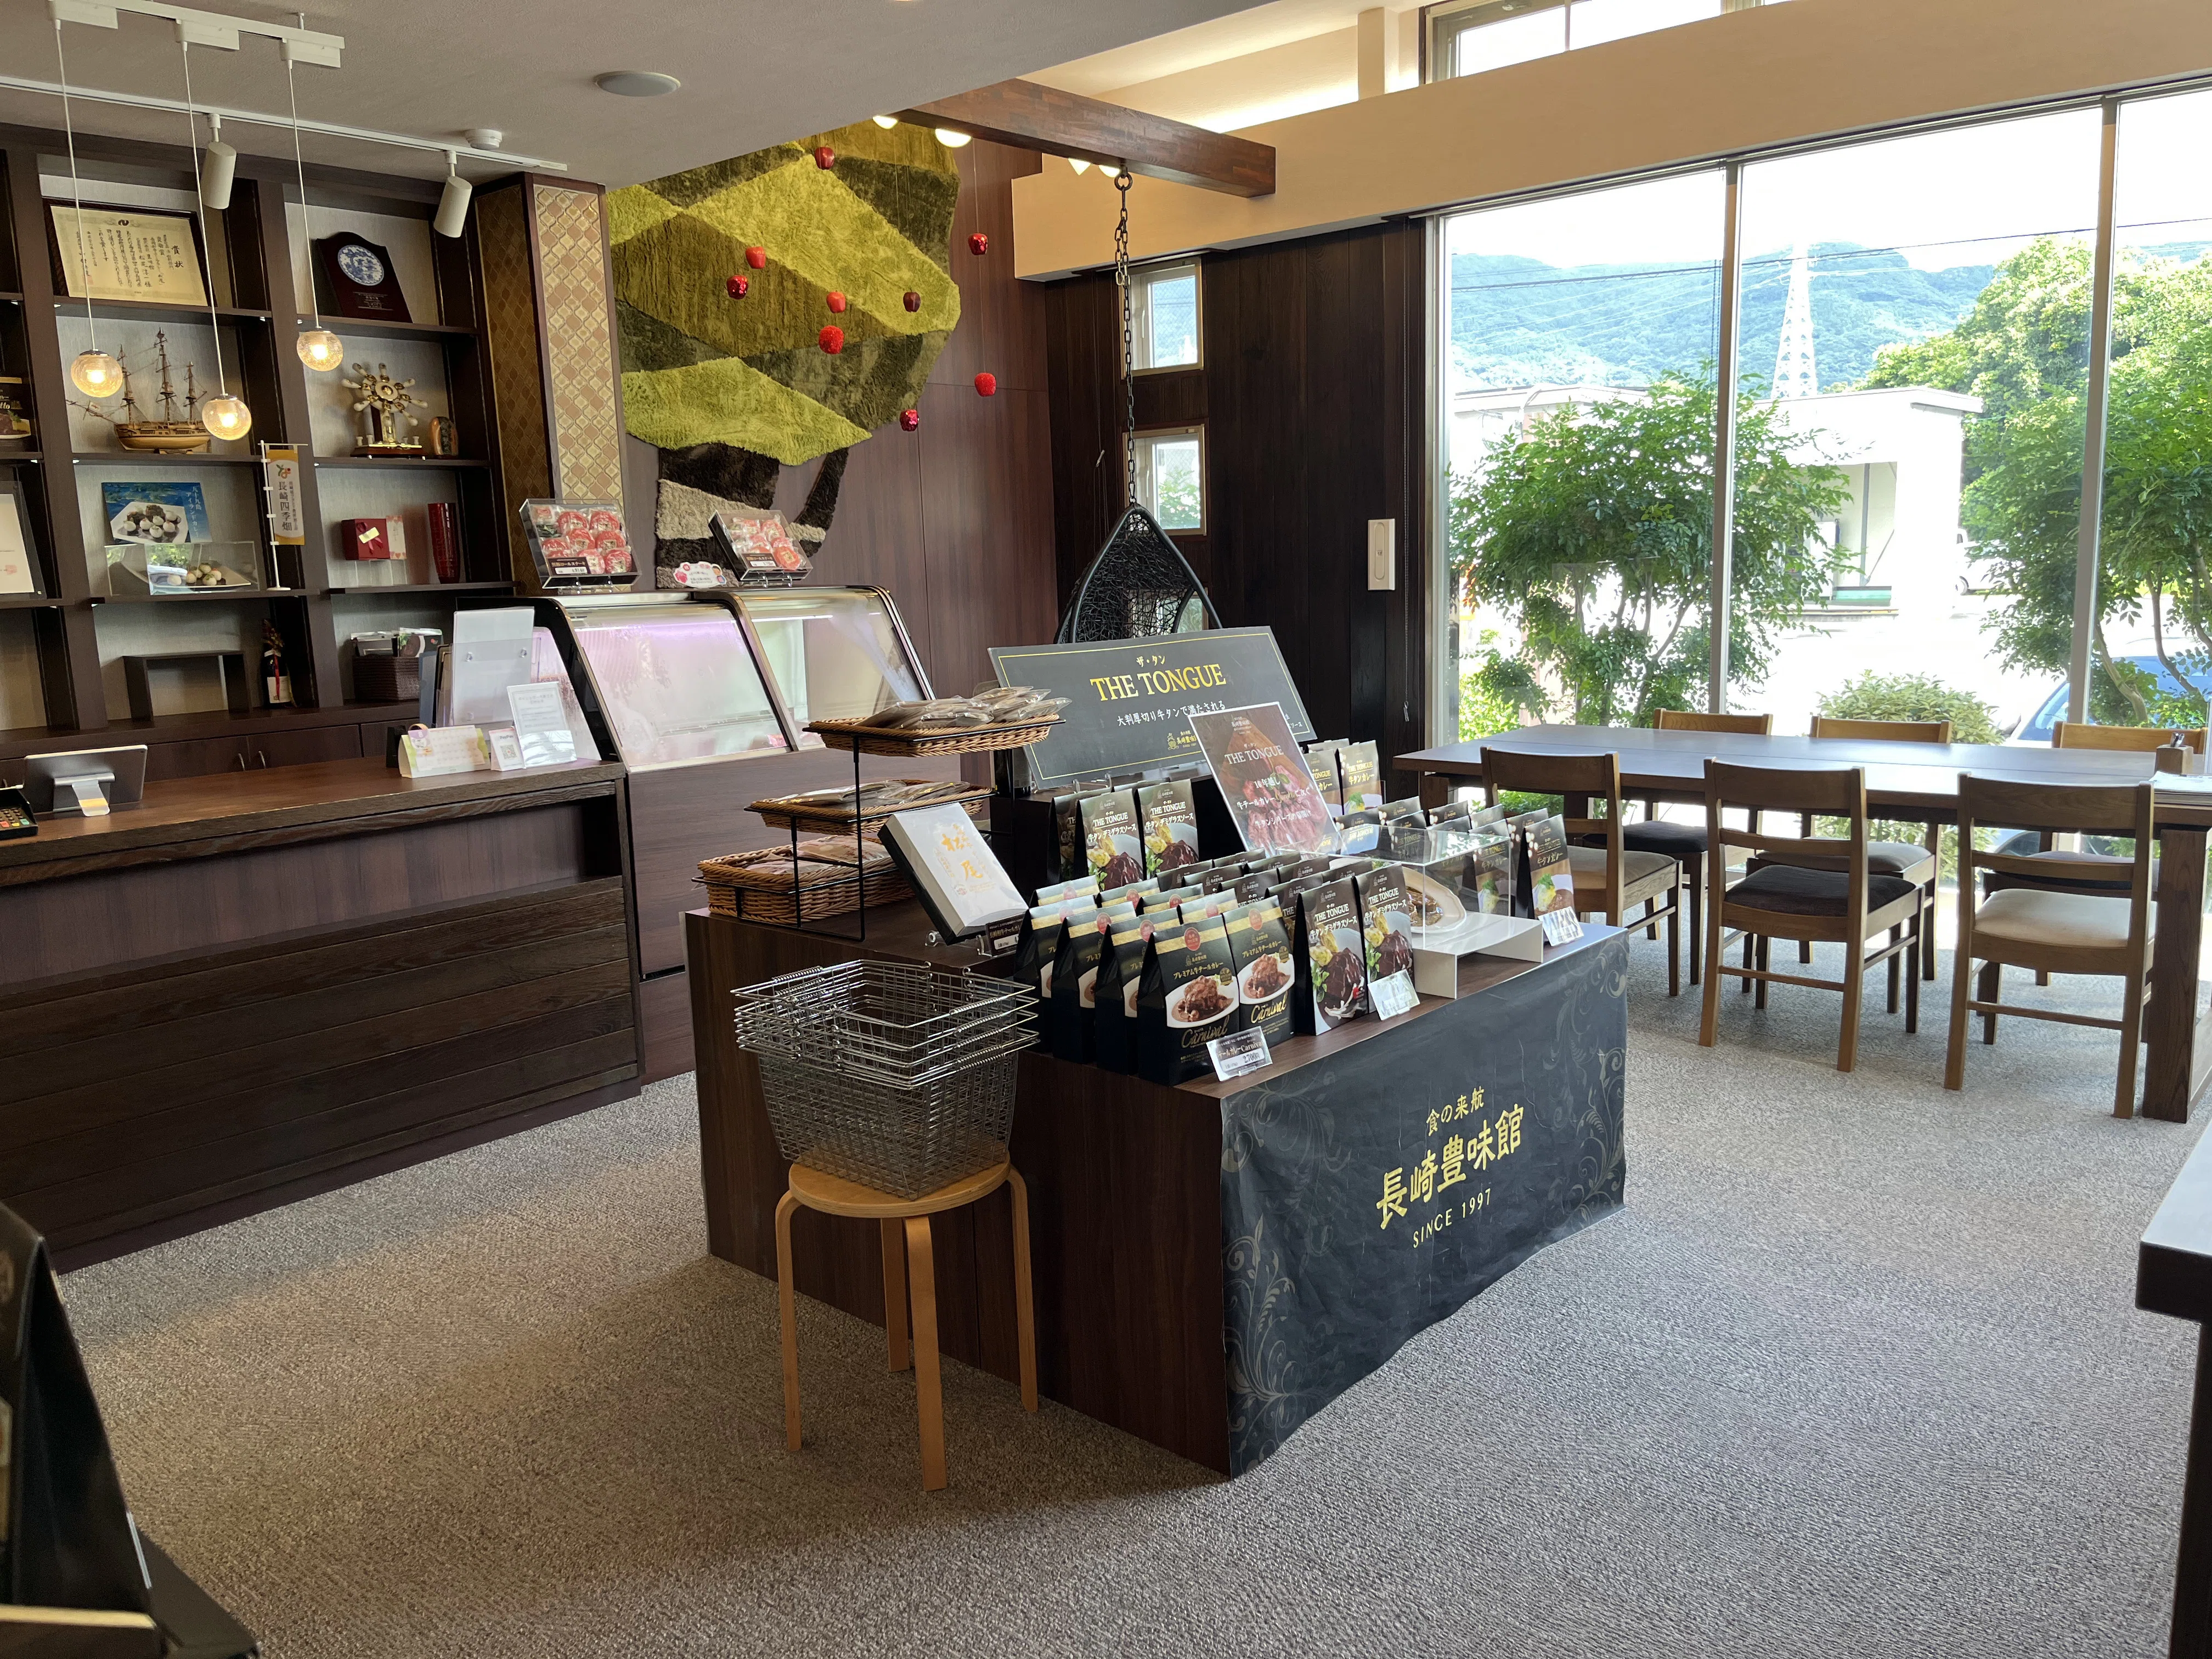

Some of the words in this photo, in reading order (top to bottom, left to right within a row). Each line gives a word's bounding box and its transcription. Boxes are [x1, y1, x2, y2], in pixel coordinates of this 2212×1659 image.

[171, 245, 184, 268] 賞状
[278, 481, 292, 531] 長崎四季畑
[1136, 655, 1166, 667] ザ・タン
[1090, 674, 1139, 702] THE
[1137, 663, 1227, 695] TONGUE
[1116, 700, 1226, 727] 大判厚切り牛タンで満たされる
[1224, 751, 1246, 765] THE
[1244, 745, 1284, 761] TONGUE
[1312, 770, 1331, 780] TONGUE
[1357, 761, 1373, 771] TONGUE
[1151, 806, 1162, 815] THE
[1163, 802, 1186, 812] TONGUE
[1068, 816, 1076, 825] TH
[1093, 817, 1104, 827] THE
[1105, 812, 1128, 824] TONGUE
[941, 833, 983, 881] 松尾
[1368, 896, 1379, 904] THE
[1379, 888, 1400, 901] TONGUE
[1283, 906, 1295, 917] THE
[1314, 911, 1327, 922] THE
[1327, 903, 1350, 918] TONGUE
[1251, 990, 1288, 1024] Carnival
[1181, 1014, 1230, 1048] Carnival
[1426, 1086, 1485, 1137] 食の来航
[1375, 1103, 1525, 1230] 長崎豊味館
[1413, 1208, 1453, 1249] SINCE
[1462, 1187, 1491, 1218] 1997
